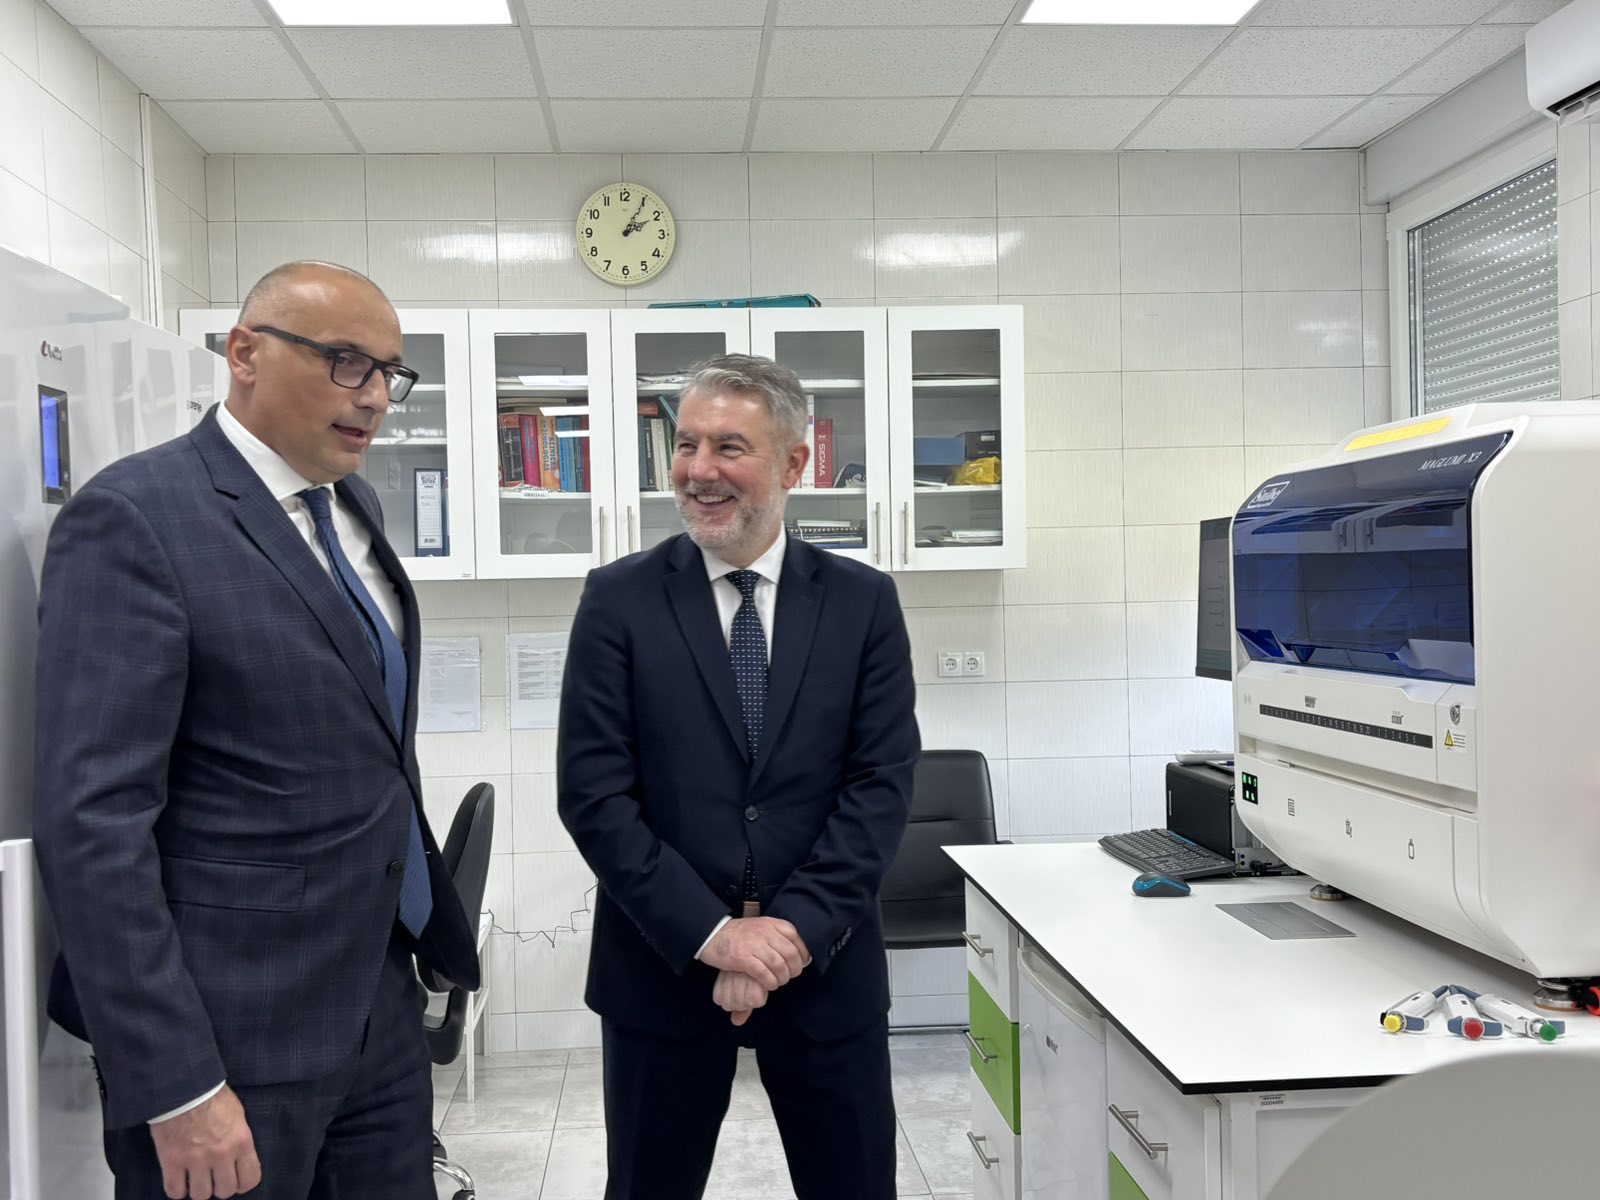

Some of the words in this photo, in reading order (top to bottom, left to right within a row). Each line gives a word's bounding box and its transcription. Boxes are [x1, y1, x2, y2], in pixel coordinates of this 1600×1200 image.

[604, 196, 610, 206] 11
[620, 191, 630, 202] 12
[589, 209, 600, 220] 10
[652, 210, 661, 221] 2
[585, 227, 593, 238] 9
[658, 229, 666, 240] 3
[590, 246, 598, 257] 8
[652, 247, 661, 258] 4
[603, 260, 612, 271] 7
[621, 265, 630, 276] 6
[640, 260, 648, 272] 5
[818, 443, 826, 477] SIGMA
[1417, 454, 1467, 471] MAGLUMI
